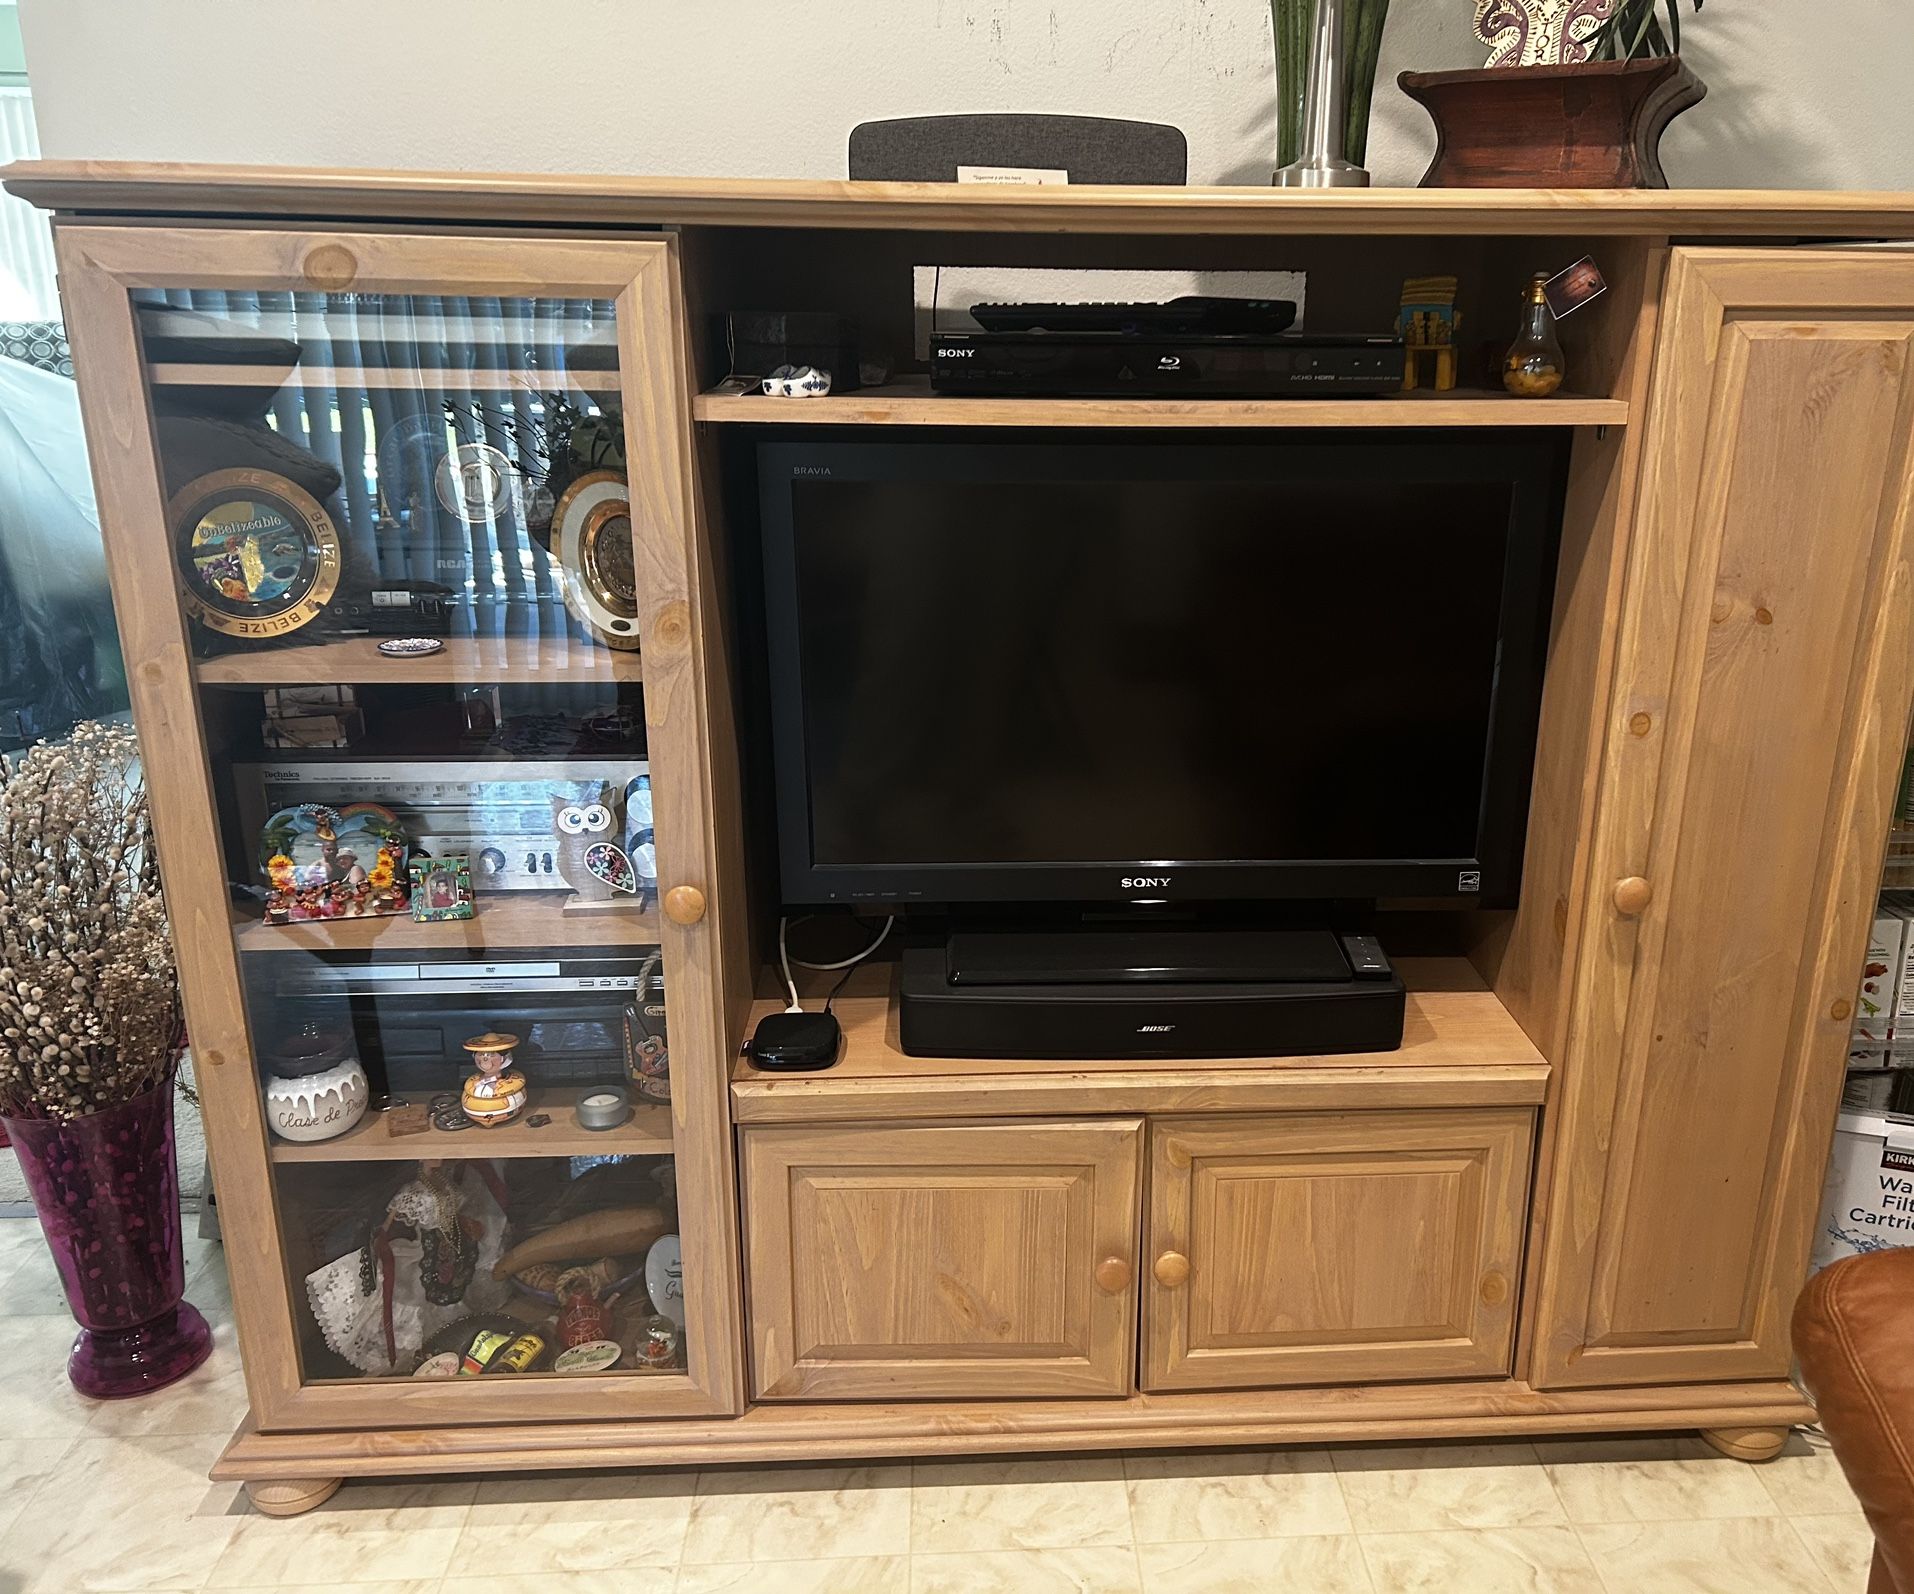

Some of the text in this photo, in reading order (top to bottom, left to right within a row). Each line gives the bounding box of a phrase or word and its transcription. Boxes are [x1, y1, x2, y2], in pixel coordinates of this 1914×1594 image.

[1533, 22, 1551, 66] TOR
[938, 349, 975, 357] SONY
[793, 467, 831, 475] BRAVIA
[311, 511, 335, 568] BELIZE
[437, 560, 466, 569] RCA
[239, 612, 302, 633] BELIZE
[1121, 878, 1171, 888] SONY
[279, 1112, 319, 1128] Clase
[324, 1107, 341, 1124] de
[1880, 1175, 1913, 1194] Wa
